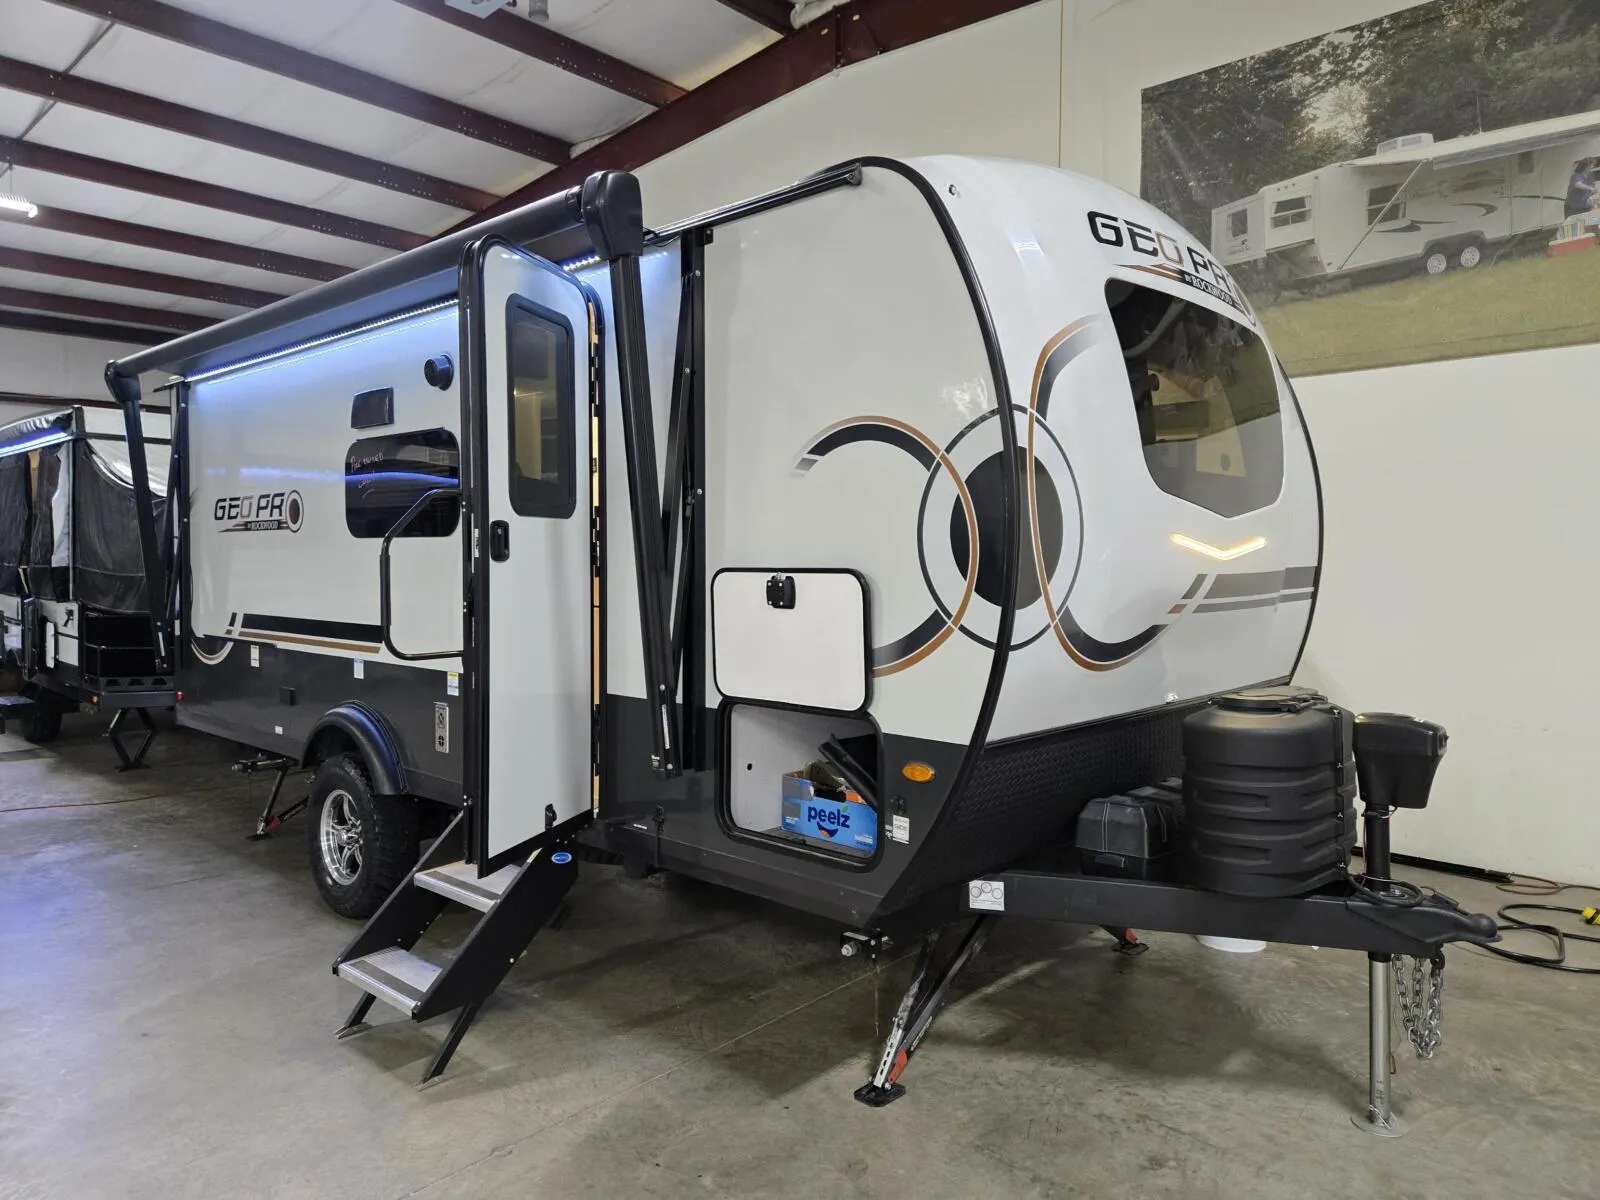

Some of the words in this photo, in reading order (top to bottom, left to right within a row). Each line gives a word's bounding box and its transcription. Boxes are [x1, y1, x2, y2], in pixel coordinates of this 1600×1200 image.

[1087, 211, 1184, 266] GEO
[214, 496, 254, 520] GEO
[808, 805, 850, 829] peelz
